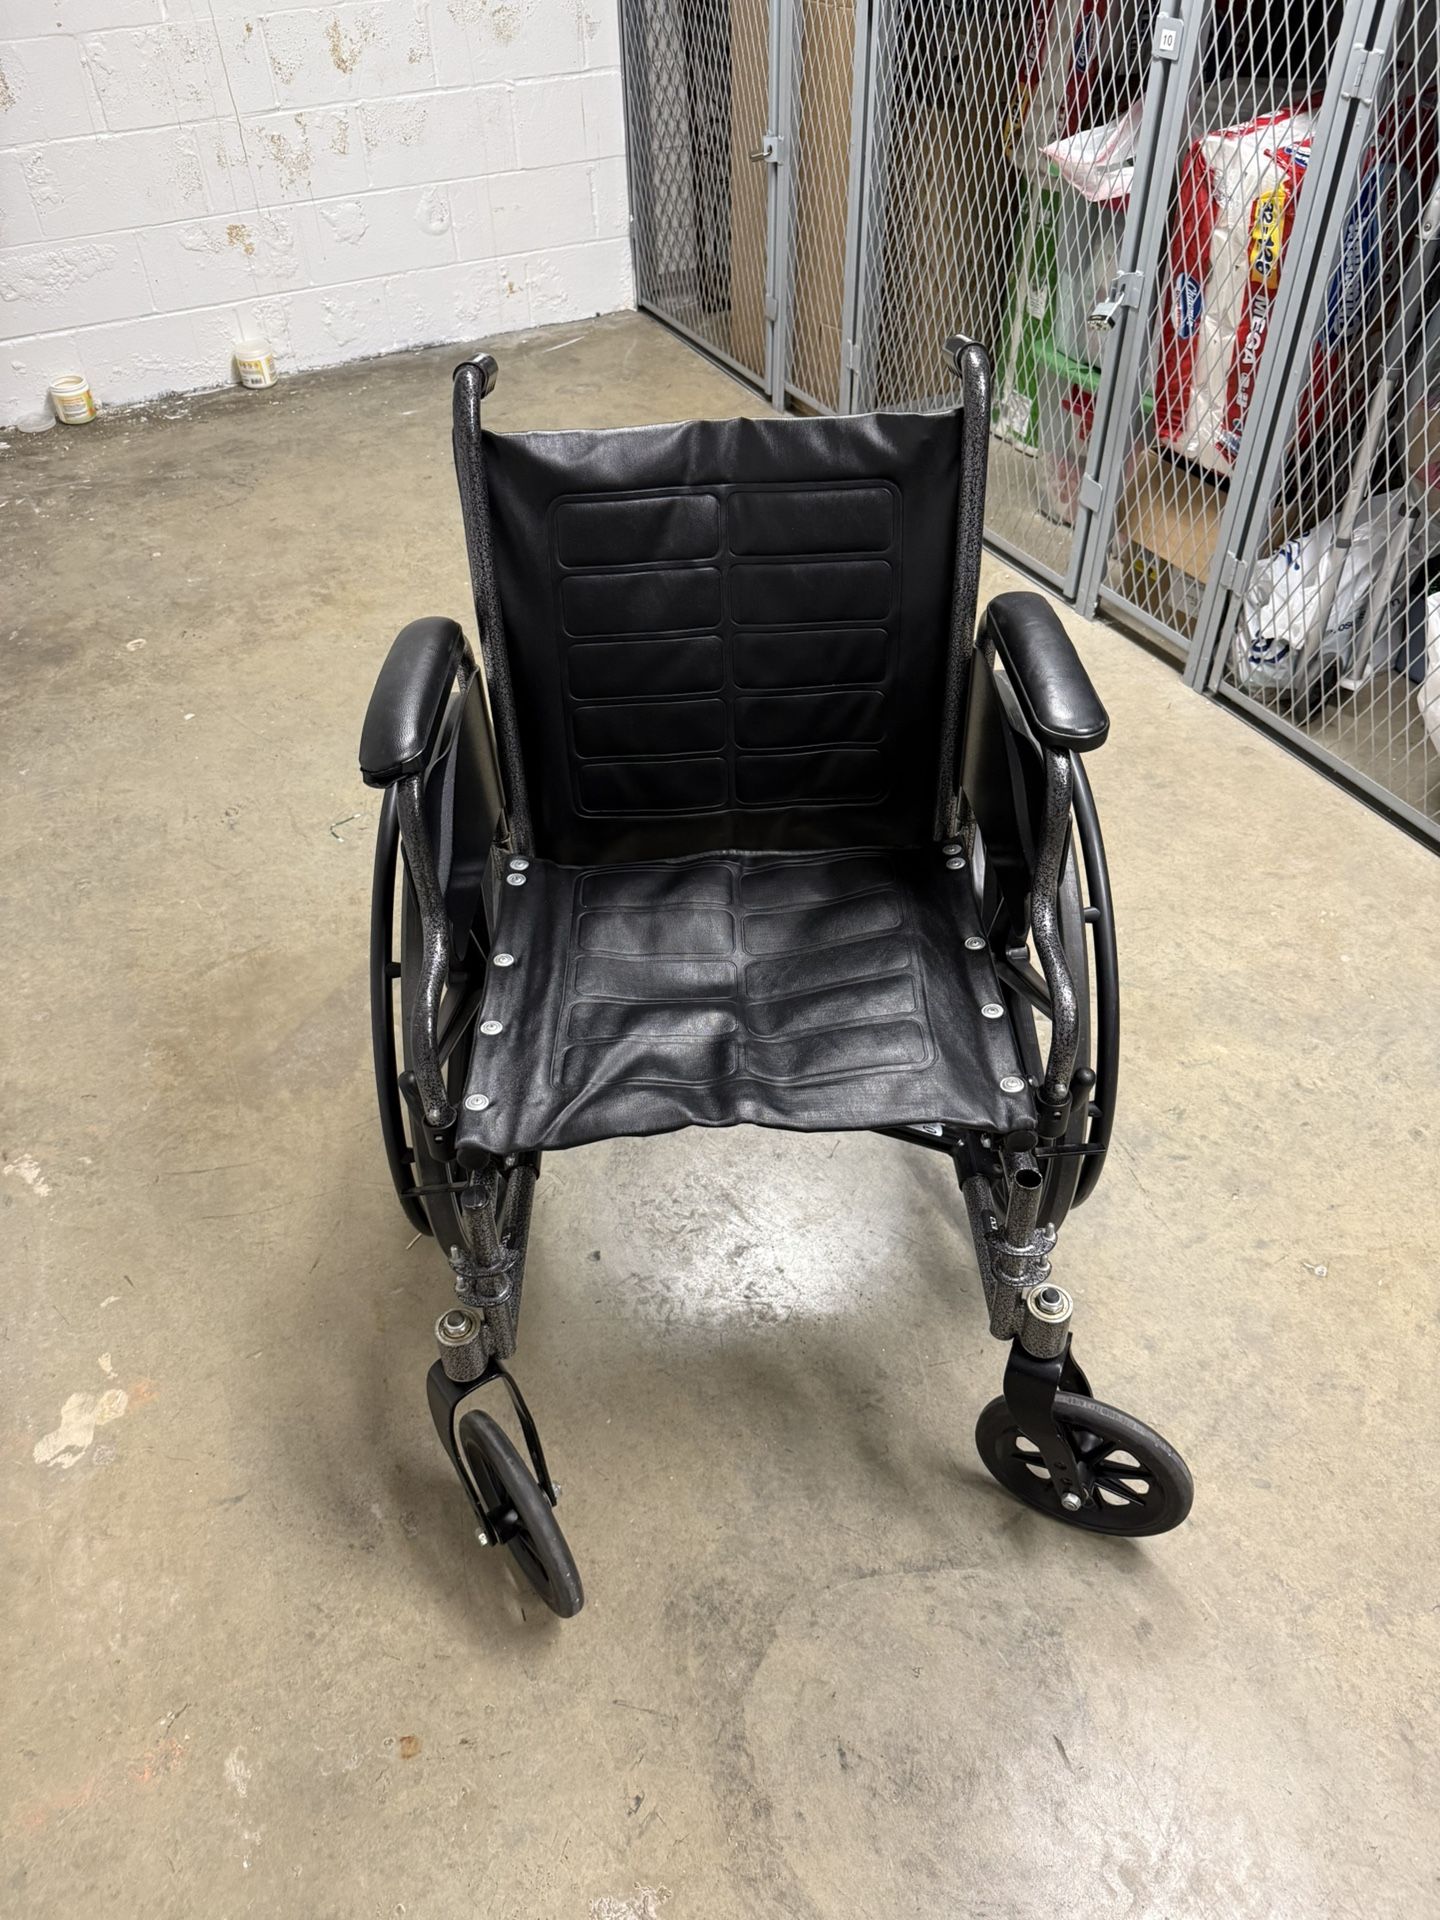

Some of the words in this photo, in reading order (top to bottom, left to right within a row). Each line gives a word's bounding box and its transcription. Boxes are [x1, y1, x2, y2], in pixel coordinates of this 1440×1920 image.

[1163, 34, 1173, 46] 10
[1261, 203, 1274, 224] 32
[1242, 294, 1267, 365] MEGA
